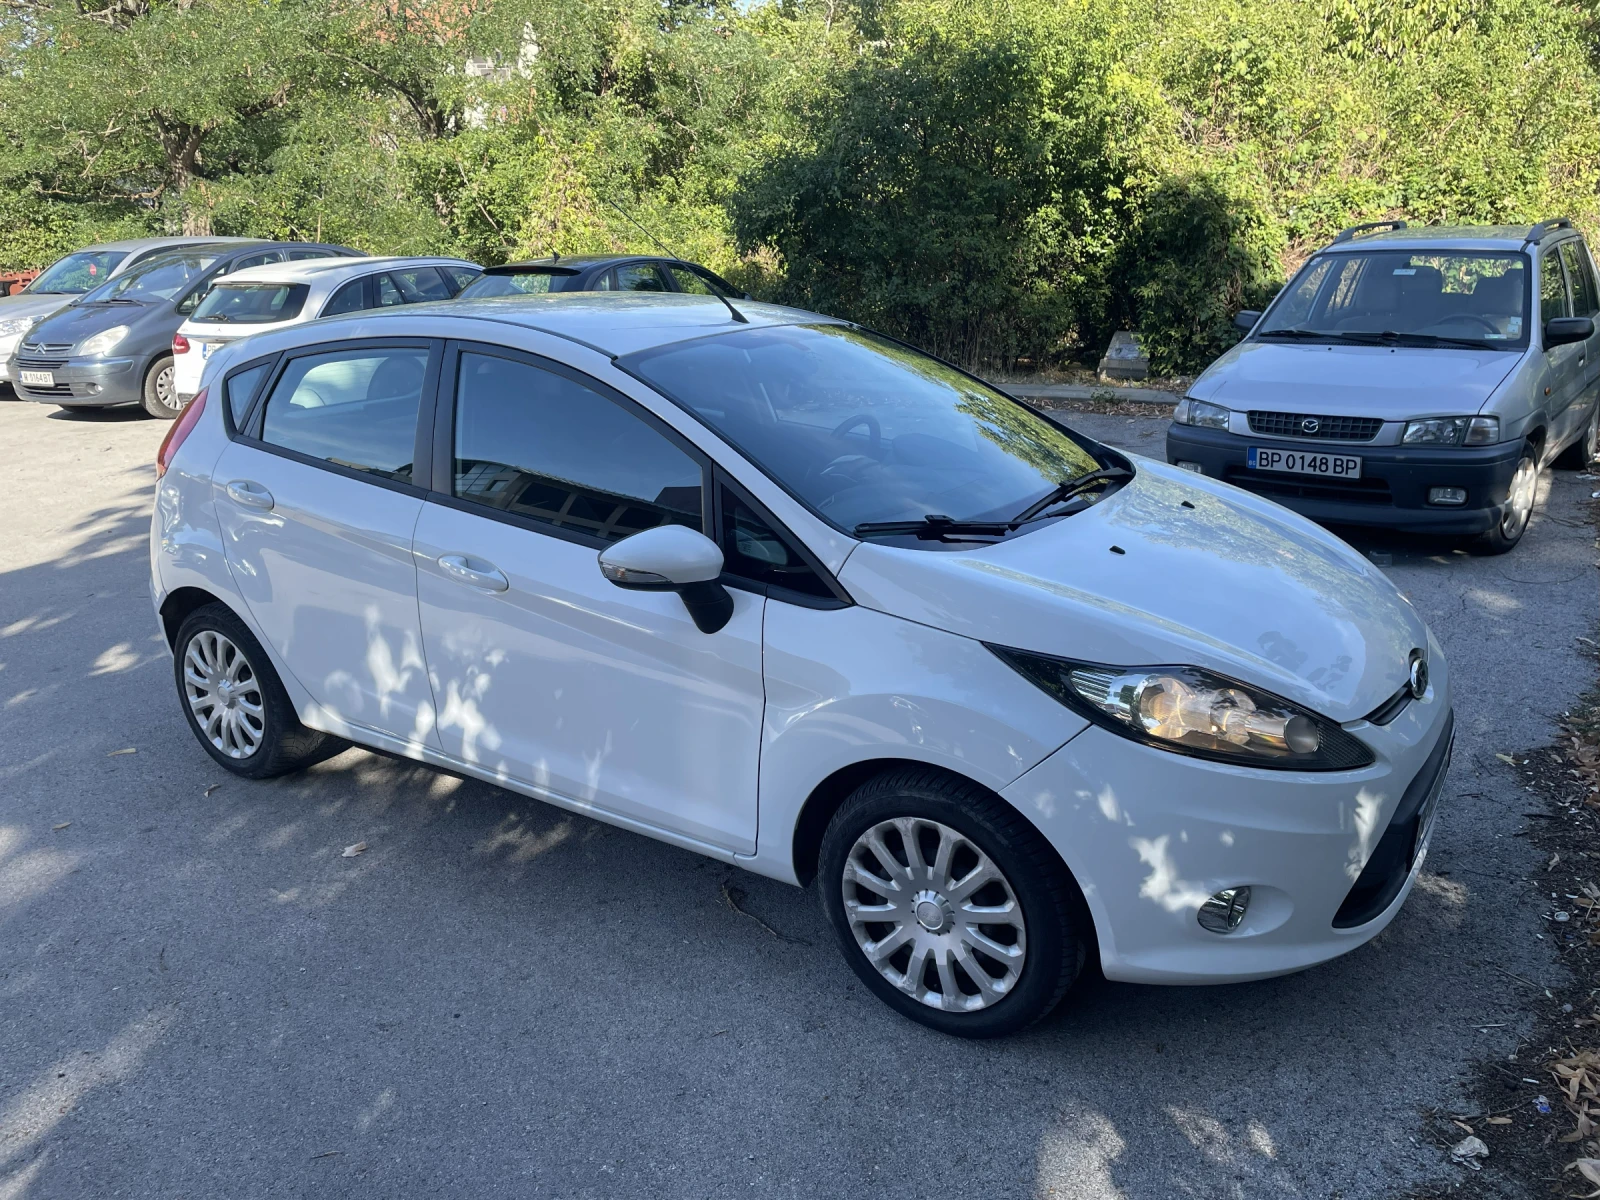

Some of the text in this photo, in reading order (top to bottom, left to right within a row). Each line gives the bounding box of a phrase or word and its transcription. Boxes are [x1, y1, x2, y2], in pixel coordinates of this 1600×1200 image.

[1258, 451, 1357, 475] BP 0148 BP
